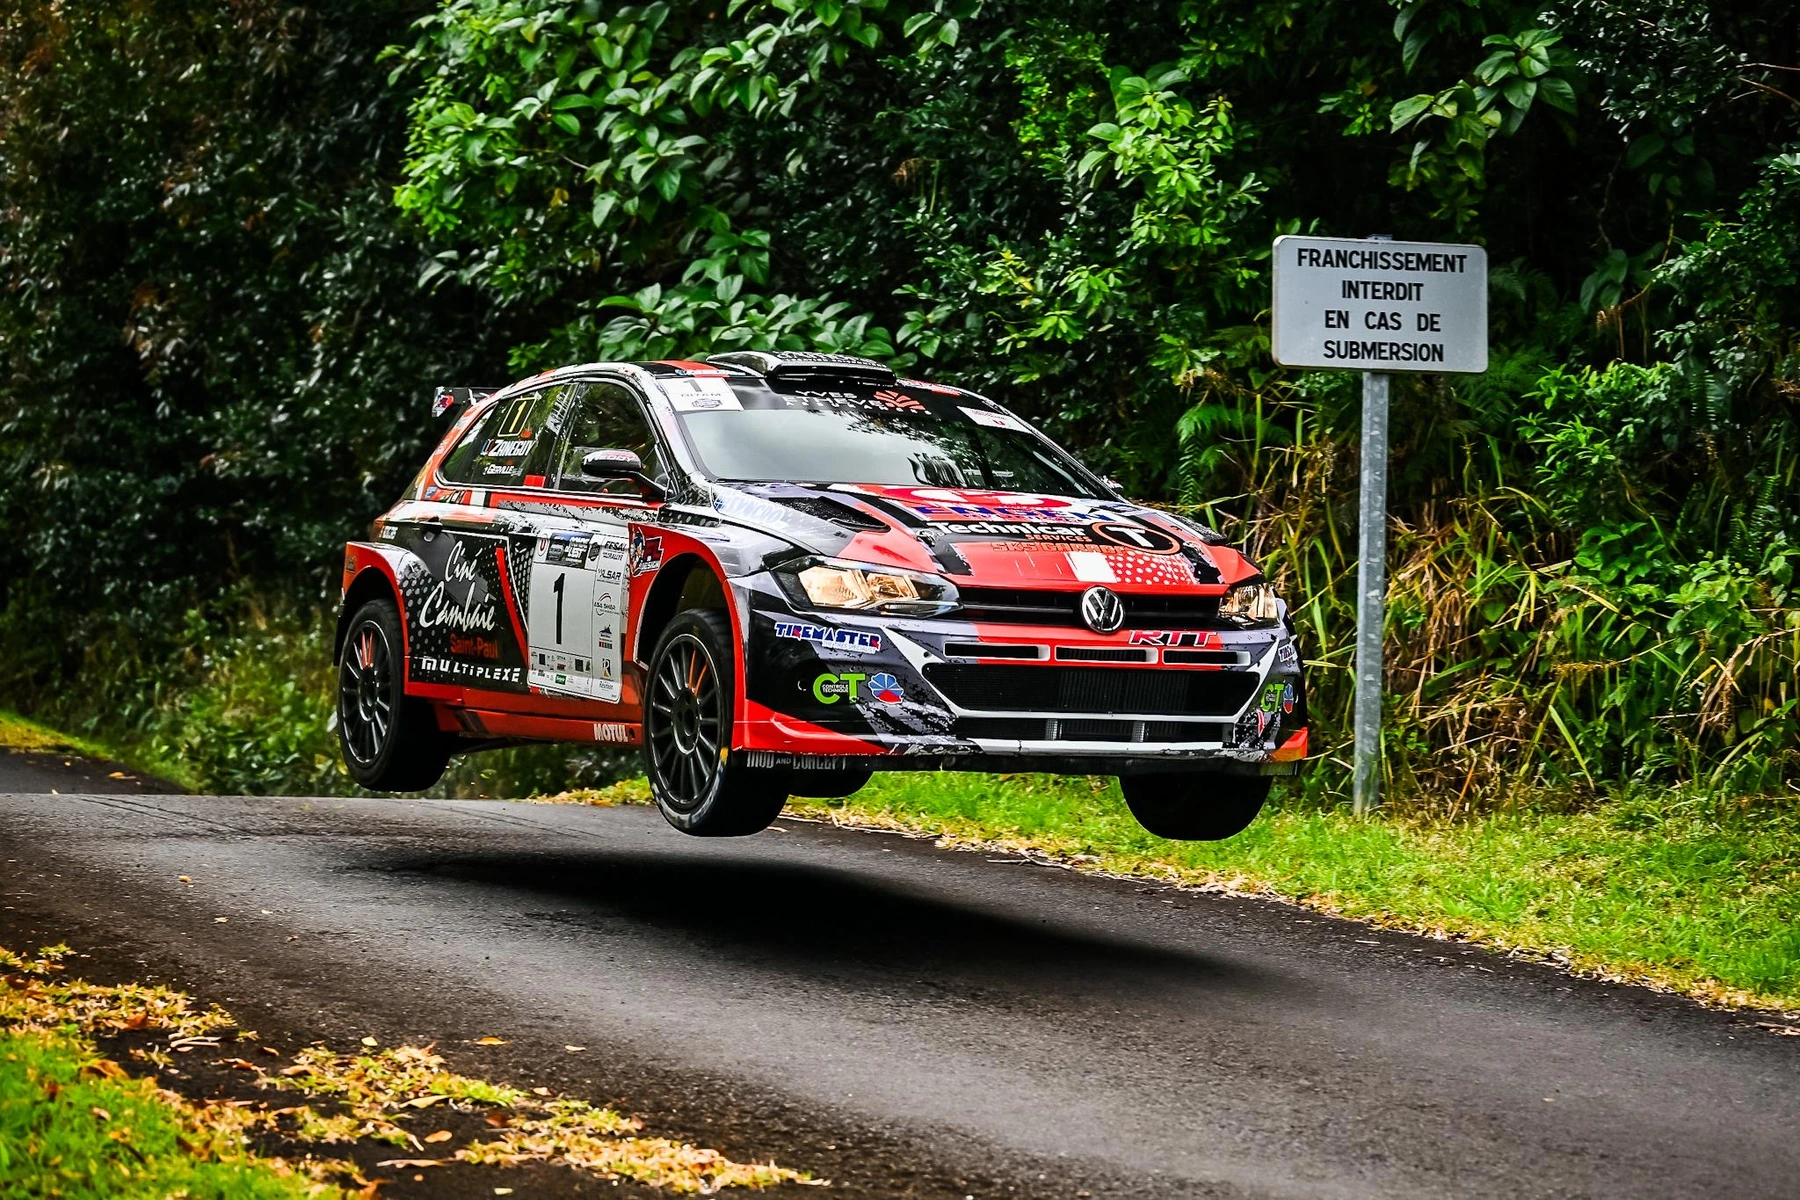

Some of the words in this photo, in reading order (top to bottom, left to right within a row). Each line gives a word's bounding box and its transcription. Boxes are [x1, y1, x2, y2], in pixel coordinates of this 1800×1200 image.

[1297, 248, 1467, 273] FRANCHISSEMENT
[1342, 280, 1424, 301] INTERDIT
[1325, 310, 1350, 329] EN
[1365, 311, 1402, 331] CAS
[1417, 313, 1441, 332] DE
[1323, 340, 1444, 362] SUBMERSION
[509, 401, 527, 433] 1
[927, 521, 1086, 536] Technicar
[1024, 533, 1092, 543] SERVICES
[445, 540, 483, 583] Ciné
[553, 573, 565, 645] 1
[450, 633, 498, 658] Saint-Paul
[775, 623, 881, 650] TIREMASTER
[1129, 630, 1217, 647] RTT
[813, 673, 866, 704] CT
[1261, 684, 1284, 712] CT
[593, 723, 628, 742] MOTUL
